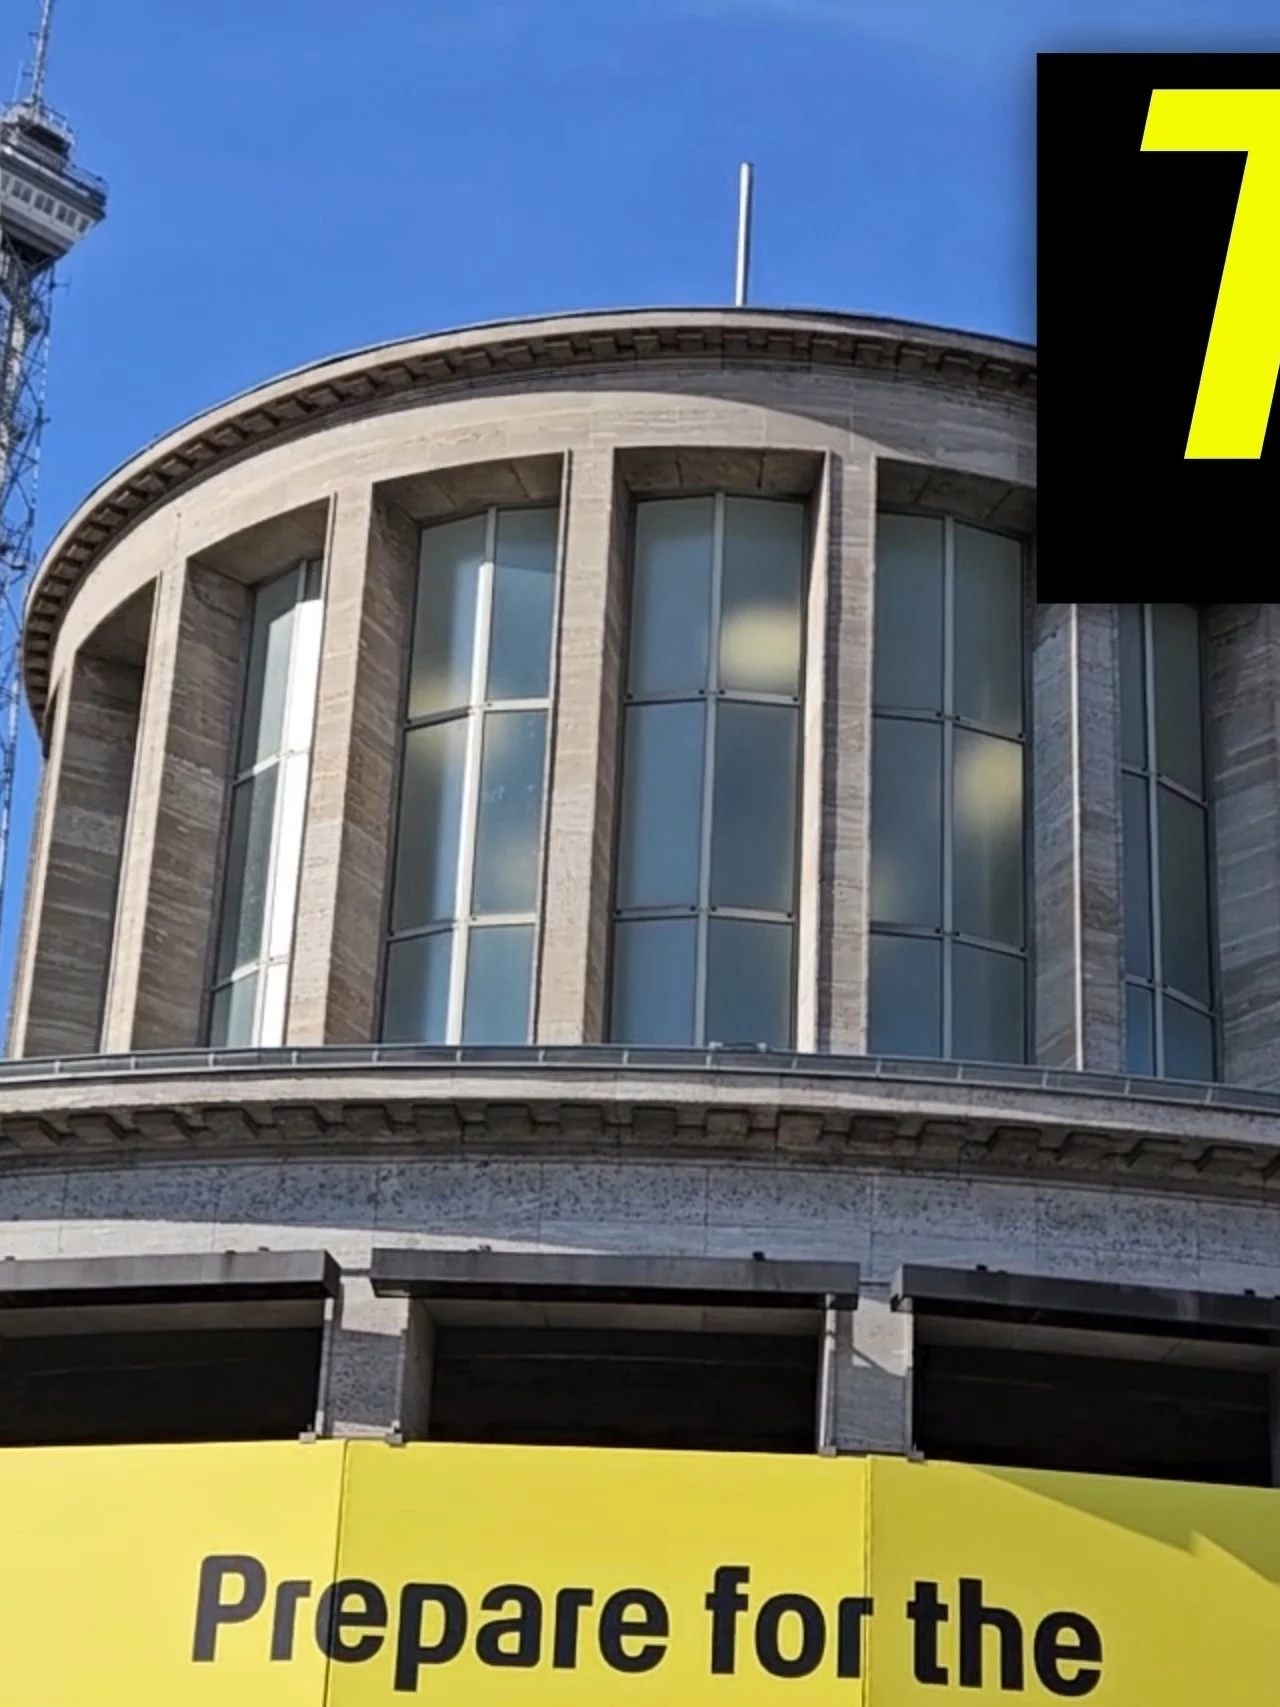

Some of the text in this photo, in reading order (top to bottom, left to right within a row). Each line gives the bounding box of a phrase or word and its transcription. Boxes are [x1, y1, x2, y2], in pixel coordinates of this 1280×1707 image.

[192, 1554, 1103, 1698] Prepare for the
